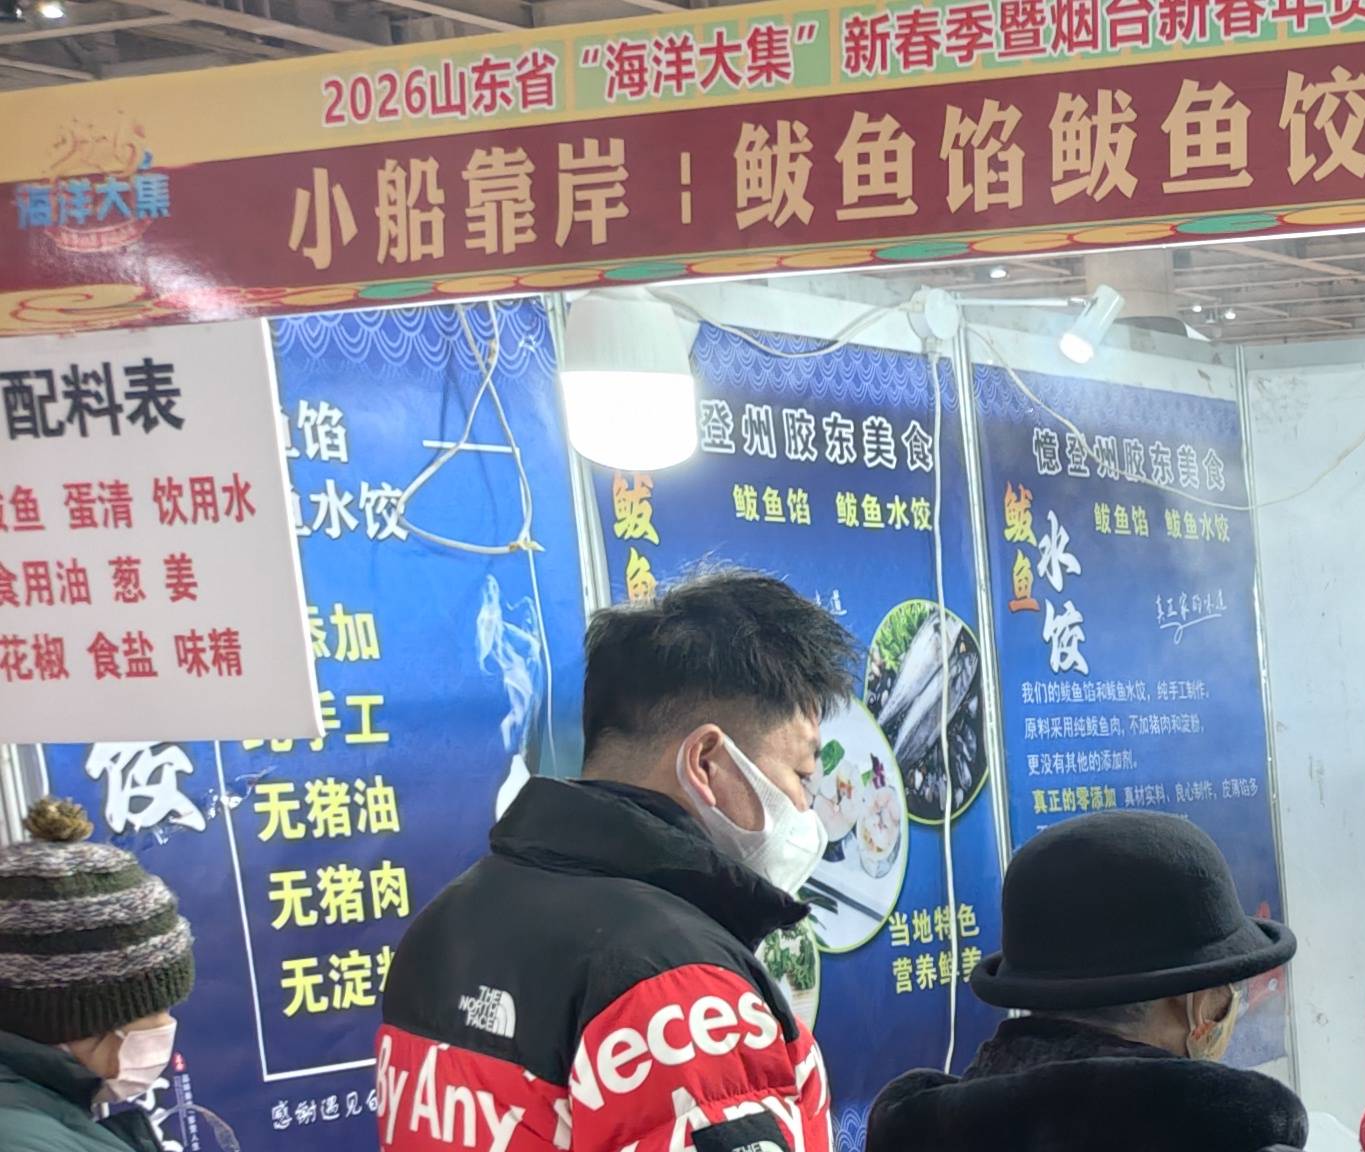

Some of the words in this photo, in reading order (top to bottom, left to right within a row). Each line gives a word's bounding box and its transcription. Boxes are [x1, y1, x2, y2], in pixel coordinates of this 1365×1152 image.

[17, 172, 171, 232] 海洋大集
[289, 138, 630, 271] 小船靠岸
[0, 357, 186, 440] 配料表
[281, 400, 349, 464] 馅
[0, 485, 46, 532] 鱼
[63, 480, 134, 530] 蛋清
[153, 473, 257, 527] 饮用水
[732, 484, 812, 526] 鲅鱼馅
[835, 491, 933, 532] 鲅鱼水饺
[1093, 502, 1150, 537] 鲅鱼馅
[1164, 508, 1231, 543] 鲅鱼水饺
[1003, 479, 1041, 614] 鲅鱼
[108, 556, 147, 603] 葱
[163, 552, 199, 602] 姜
[1036, 510, 1090, 675] 水饺
[0, 632, 69, 683] 花椒
[88, 629, 159, 681] 食盐
[174, 627, 244, 678] 味精
[253, 776, 401, 841] 无猪油
[1032, 786, 1117, 815] 真正的零添加
[268, 861, 411, 930] 无猪肉
[888, 903, 980, 948] 当地特色
[458, 995, 498, 1021] NORTH
[465, 1010, 497, 1033] FACE
[478, 985, 502, 1004] THE
